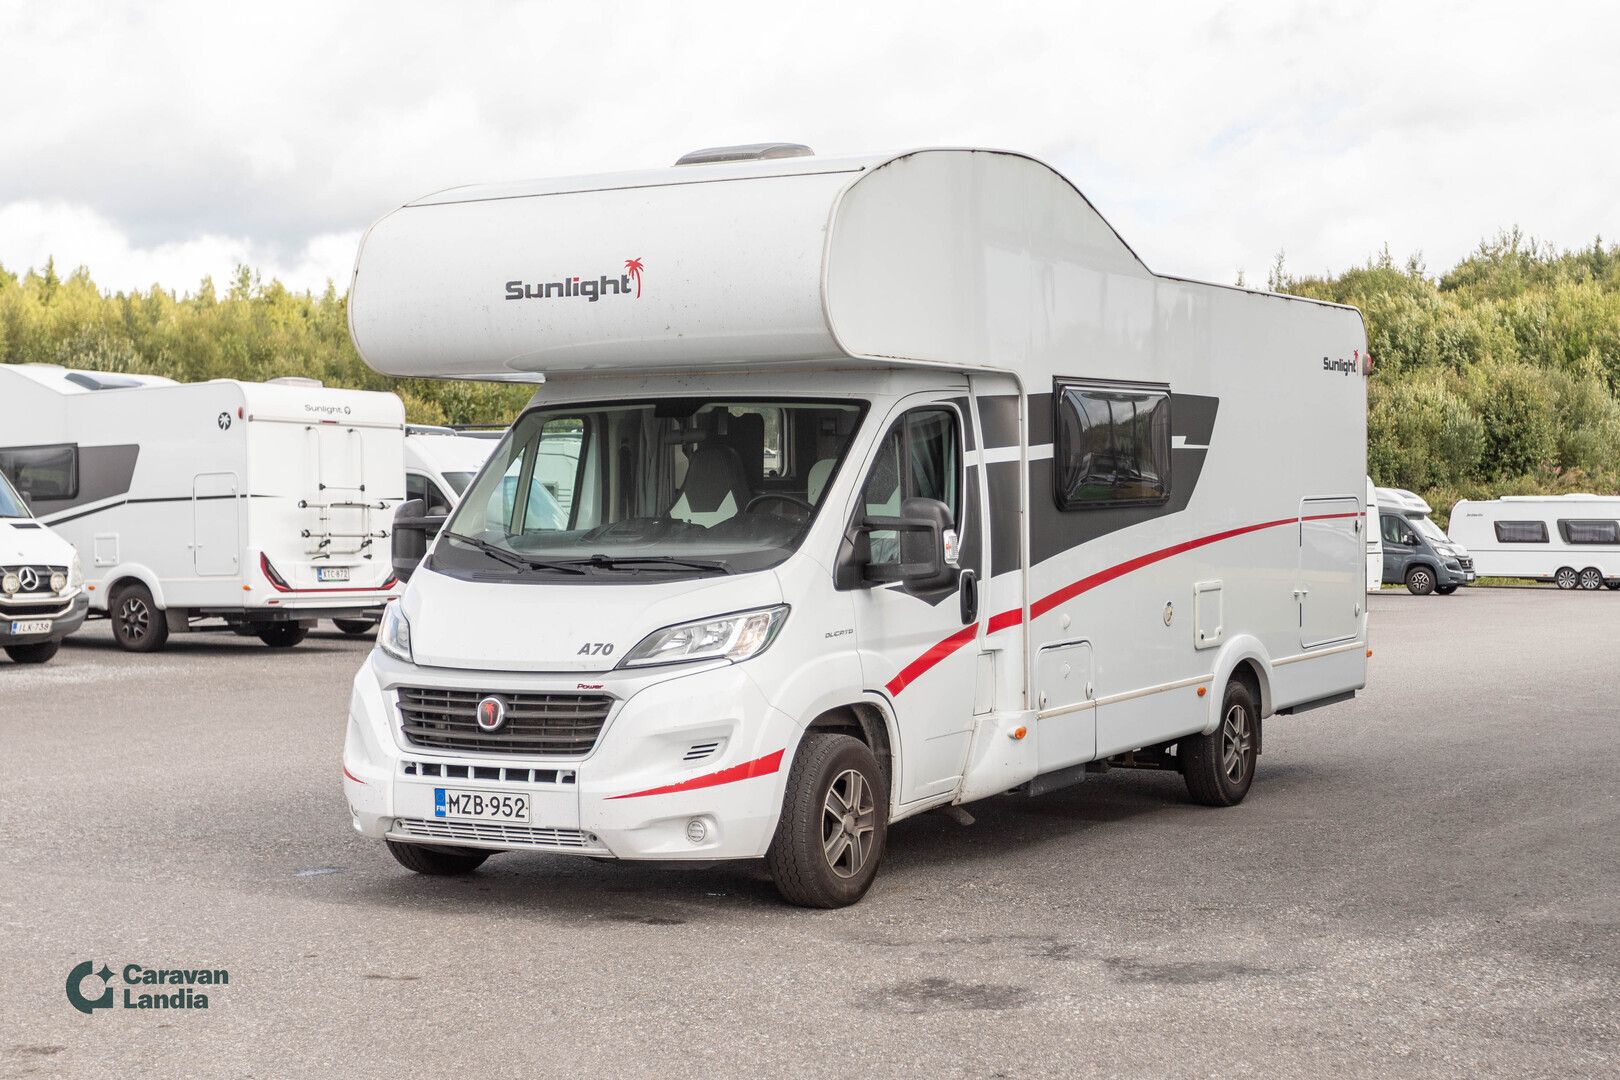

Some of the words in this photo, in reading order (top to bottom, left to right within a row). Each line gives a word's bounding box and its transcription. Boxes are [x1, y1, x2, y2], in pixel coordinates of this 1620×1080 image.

[505, 274, 631, 302] Sunlight
[1323, 356, 1356, 376] Sunlight
[304, 403, 342, 415] Sunlight
[577, 642, 614, 656] A70
[448, 794, 525, 818] MZB-952
